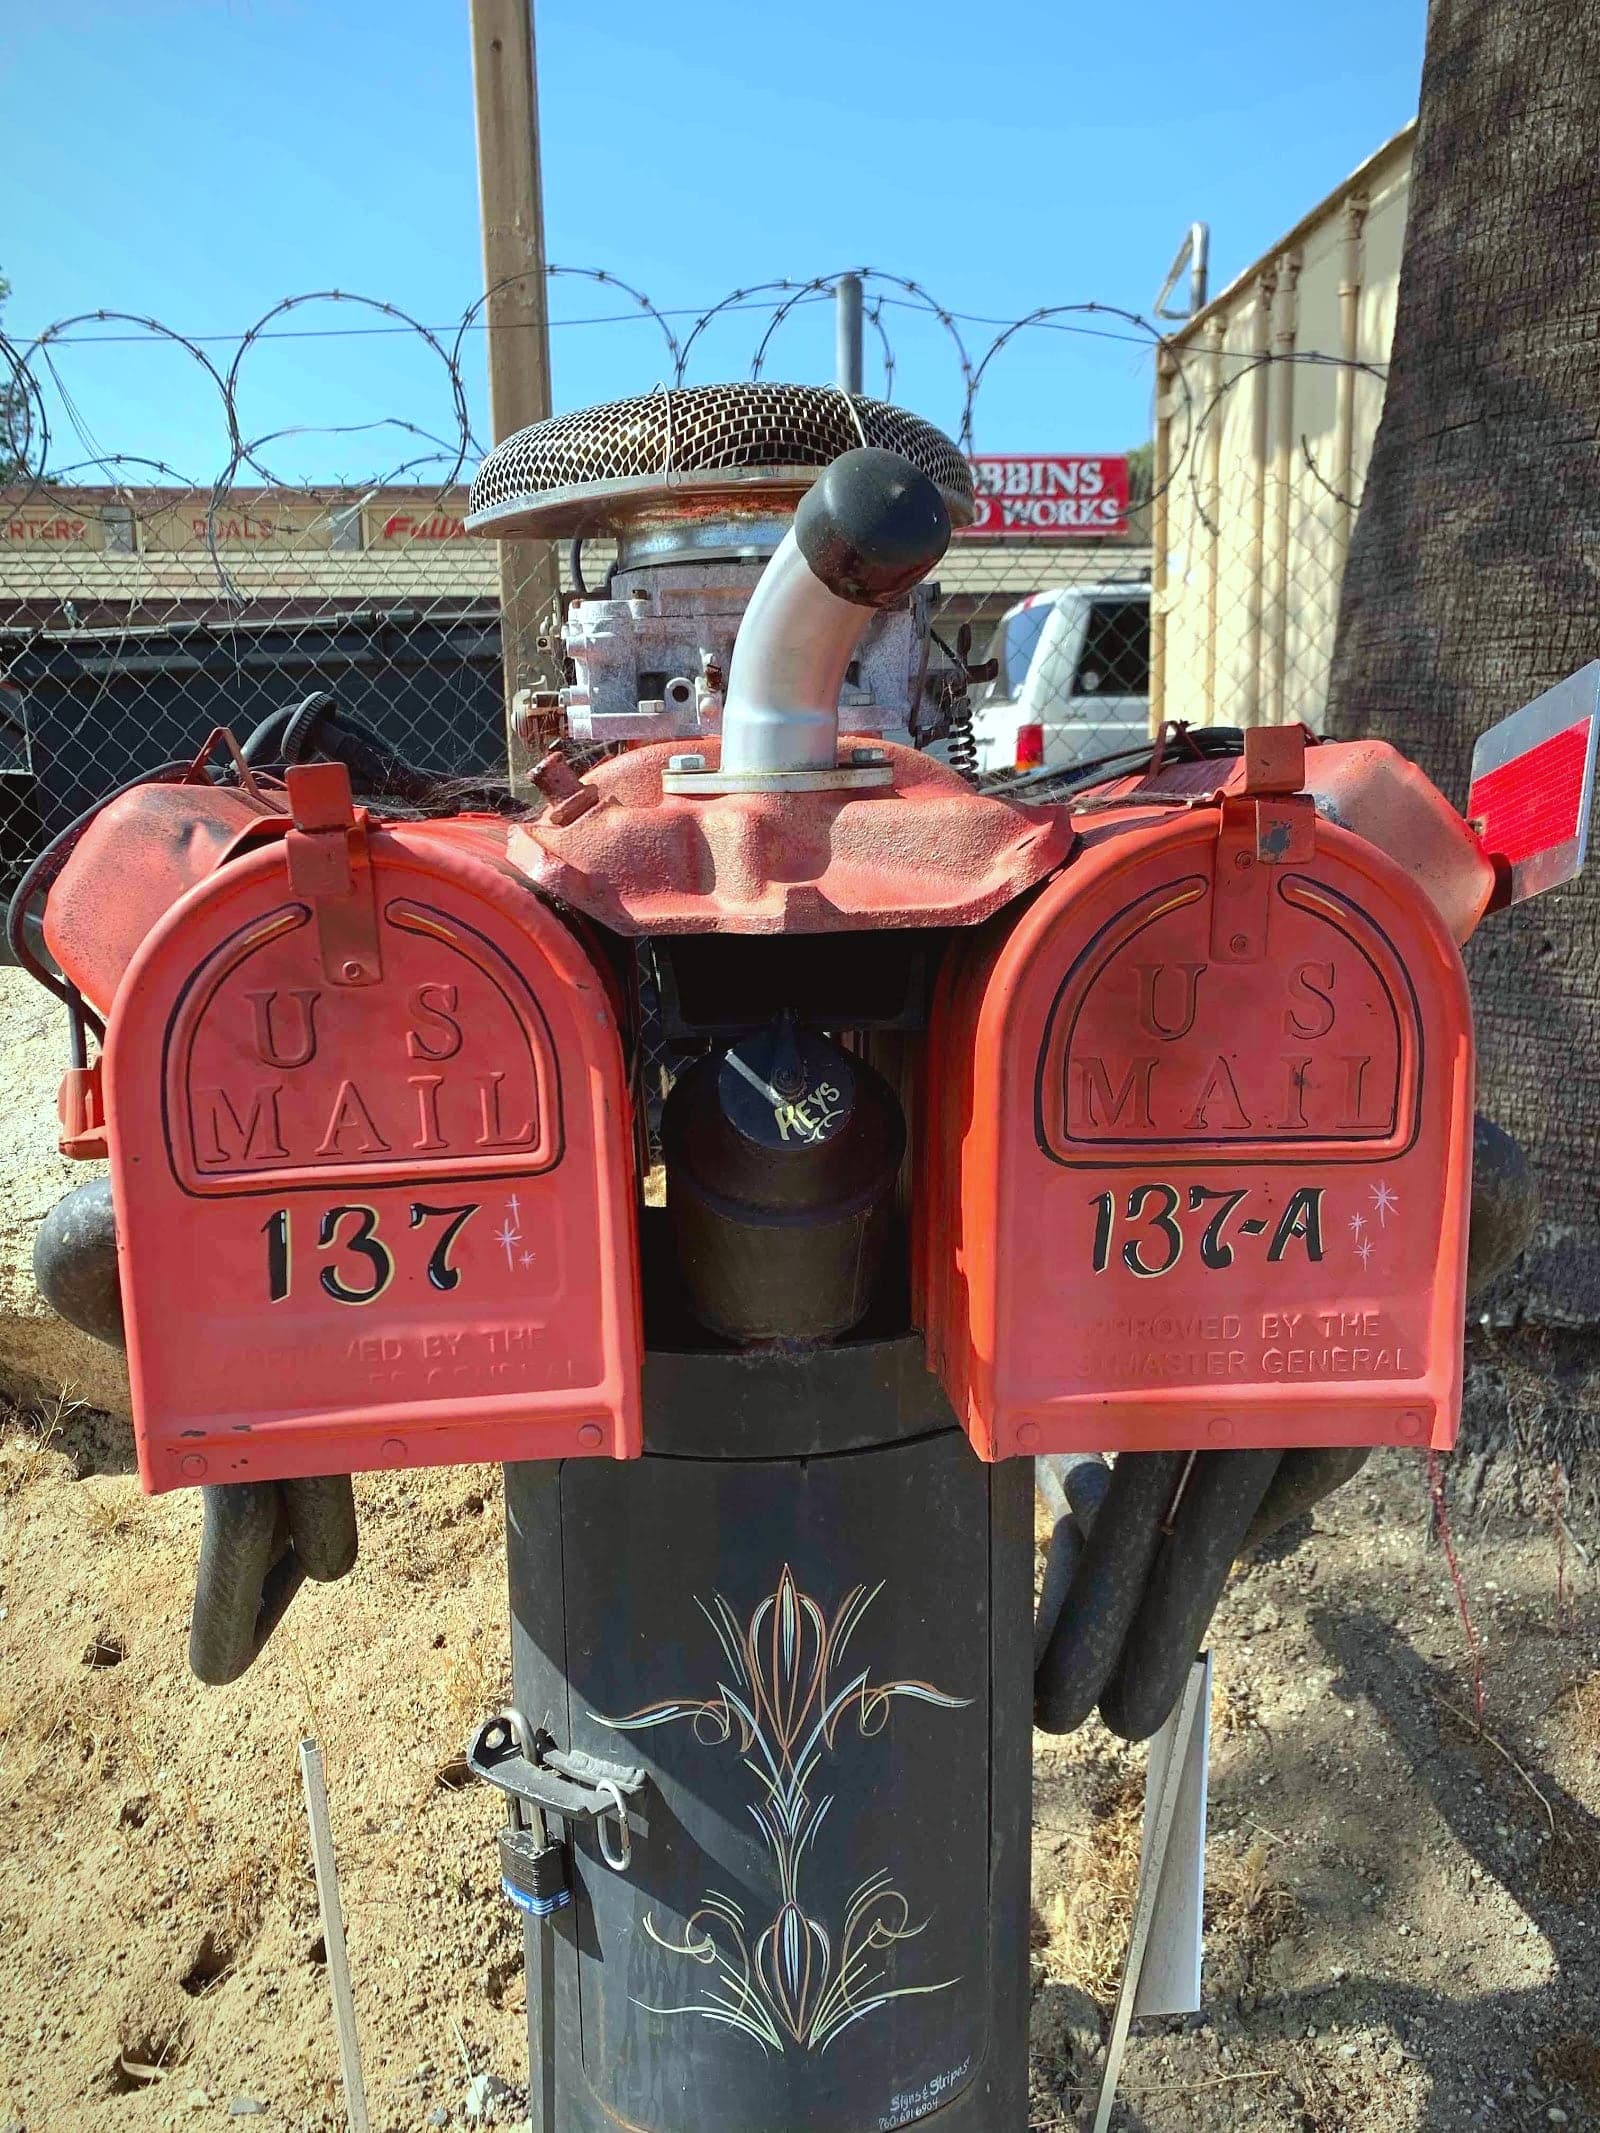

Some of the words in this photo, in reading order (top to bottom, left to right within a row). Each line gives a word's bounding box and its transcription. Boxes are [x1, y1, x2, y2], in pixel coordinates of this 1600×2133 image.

[969, 461, 1104, 496] BBINS
[2, 518, 86, 540] RTERS
[1002, 498, 1120, 527] WORKS
[244, 989, 321, 1070] U
[405, 983, 464, 1062] S
[1130, 961, 1208, 1042] U
[1284, 960, 1338, 1040] S
[194, 1072, 537, 1164] MAIL
[774, 1082, 841, 1141] KEYS
[1072, 1054, 1395, 1130] MAIL
[260, 1203, 483, 1305] 137
[1088, 1182, 1329, 1279] 137-A
[421, 1332, 464, 1360] BY
[1261, 1312, 1302, 1339] BY
[1319, 1310, 1381, 1339] THE
[1261, 1346, 1410, 1374] GENERAL
